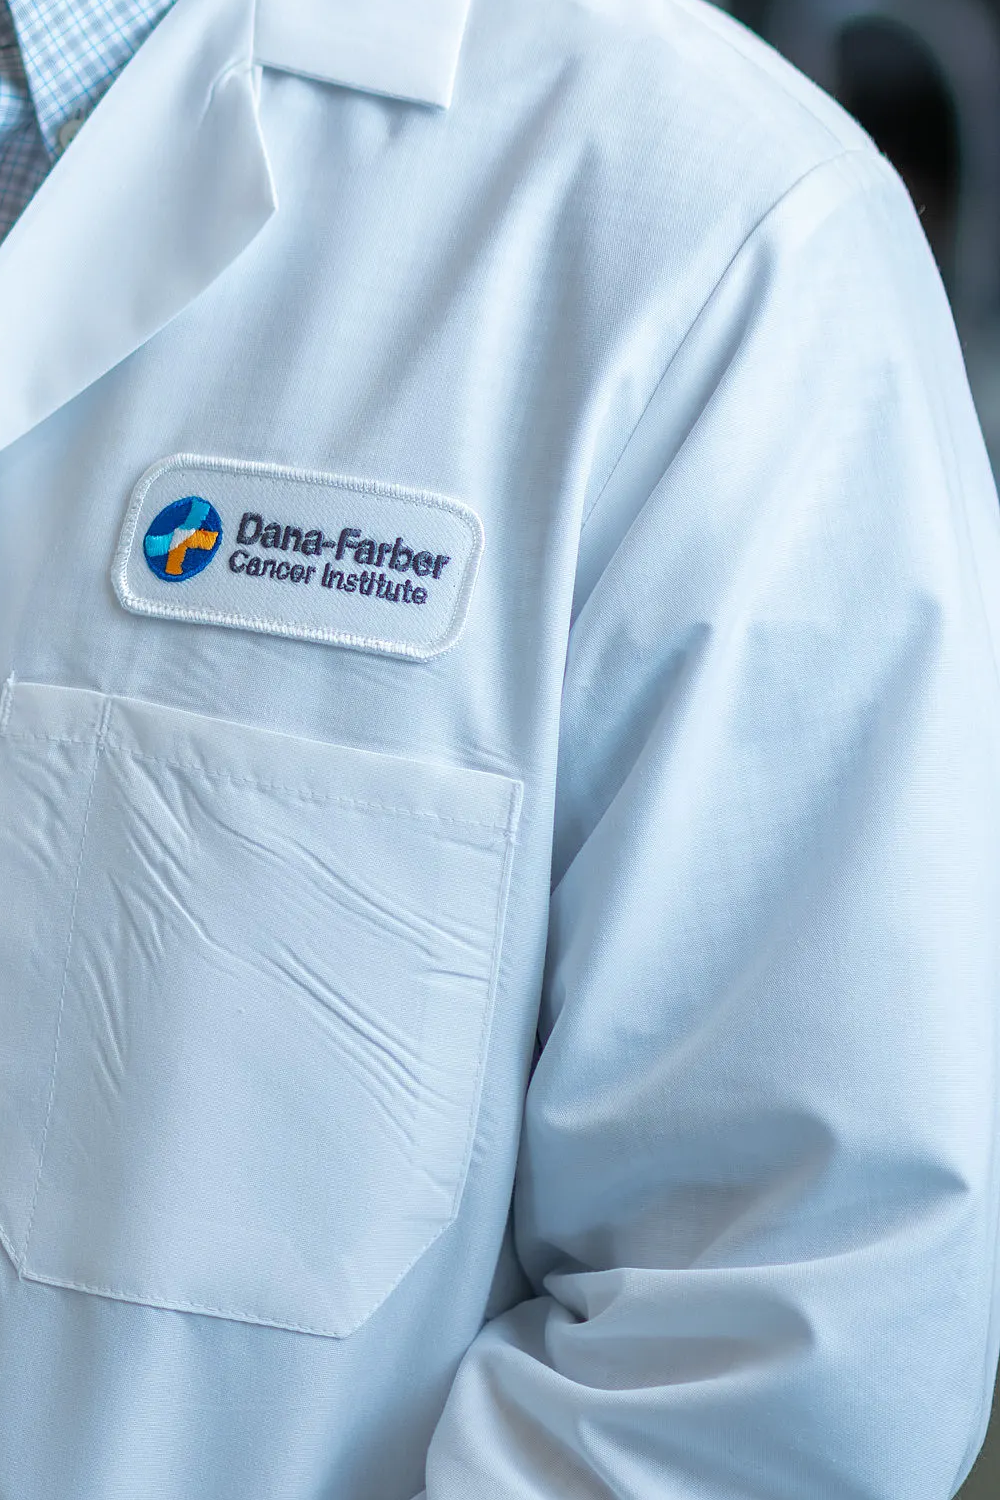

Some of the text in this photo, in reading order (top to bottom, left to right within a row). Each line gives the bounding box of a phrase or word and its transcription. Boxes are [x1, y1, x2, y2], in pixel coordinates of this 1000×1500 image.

[236, 511, 450, 580] Dana-Farber
[228, 549, 429, 605] Cancer Institute
